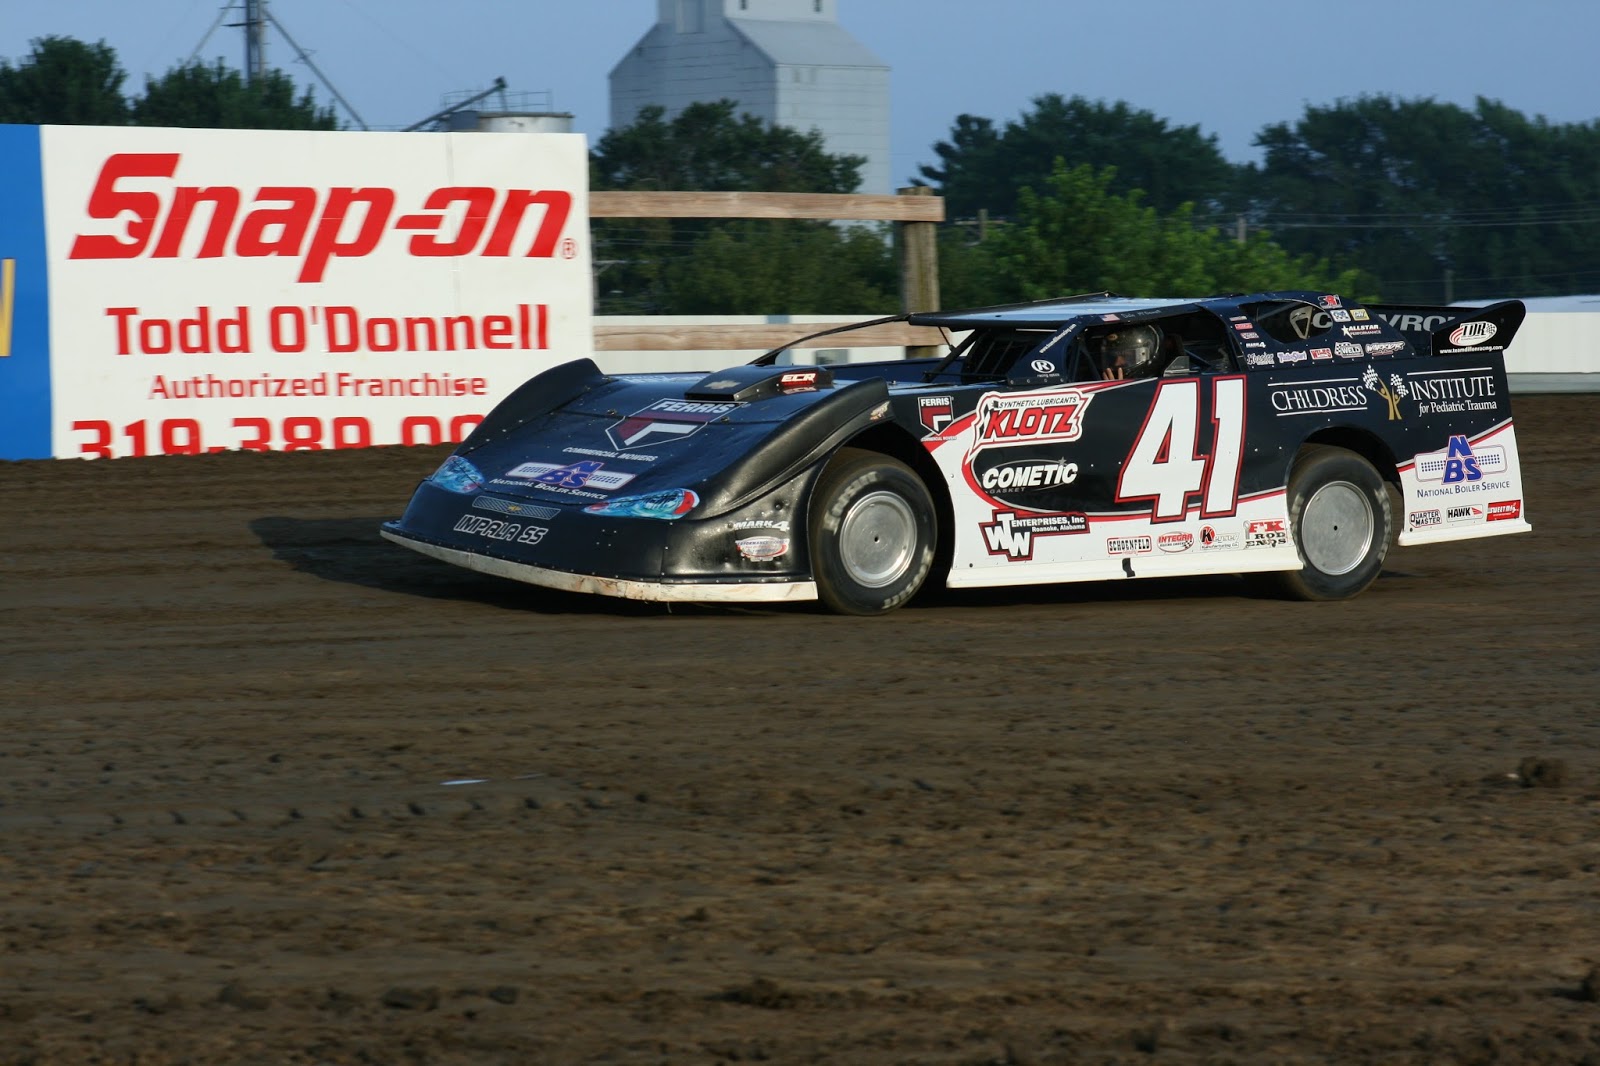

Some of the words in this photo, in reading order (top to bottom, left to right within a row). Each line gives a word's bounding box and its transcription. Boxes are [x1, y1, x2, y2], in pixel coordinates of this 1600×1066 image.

[106, 306, 251, 355] Todd
[269, 303, 551, 354] O'Donnell
[1341, 346, 1361, 354] WELD
[1439, 345, 1503, 354] www.teamdillonracing.com
[781, 373, 816, 383] ECR
[148, 372, 327, 400] Authorized
[336, 371, 487, 397] Franchise
[1271, 385, 1368, 412] CHILDRESS
[1408, 376, 1496, 401] INSTITUTE
[652, 400, 736, 414] FERRIS
[920, 397, 950, 407] FERRIS
[999, 400, 1036, 409] SYNTHETIC
[1037, 396, 1078, 406] LUBRICANTS
[1418, 402, 1430, 417] for
[1431, 401, 1465, 414] Pediatric
[1466, 399, 1498, 410] Trauma
[983, 404, 1079, 439] KLOTZ
[562, 447, 618, 459] COMMERCIAL
[1115, 375, 1247, 524] 41
[982, 463, 1079, 489] COMETIC
[489, 478, 534, 488] NATIONAL
[534, 482, 570, 495] BOILER
[567, 488, 609, 500] SERVICE
[1417, 488, 1453, 498] NATIONAL
[1455, 483, 1481, 494] BOILER
[1481, 480, 1510, 491] SERVICE
[1410, 510, 1439, 523] QUARTER
[1447, 507, 1471, 518] HAWK
[735, 520, 773, 528] MARK
[772, 520, 790, 532] 4
[1011, 516, 1070, 527] ENTERPRISES,
[1249, 520, 1285, 533] FK
[1415, 517, 1441, 526] MASTER
[453, 514, 521, 541] IMPALA
[517, 525, 549, 545] SS
[1108, 538, 1150, 551] SCHOENFELD
[1158, 533, 1193, 543] INTEGRA
